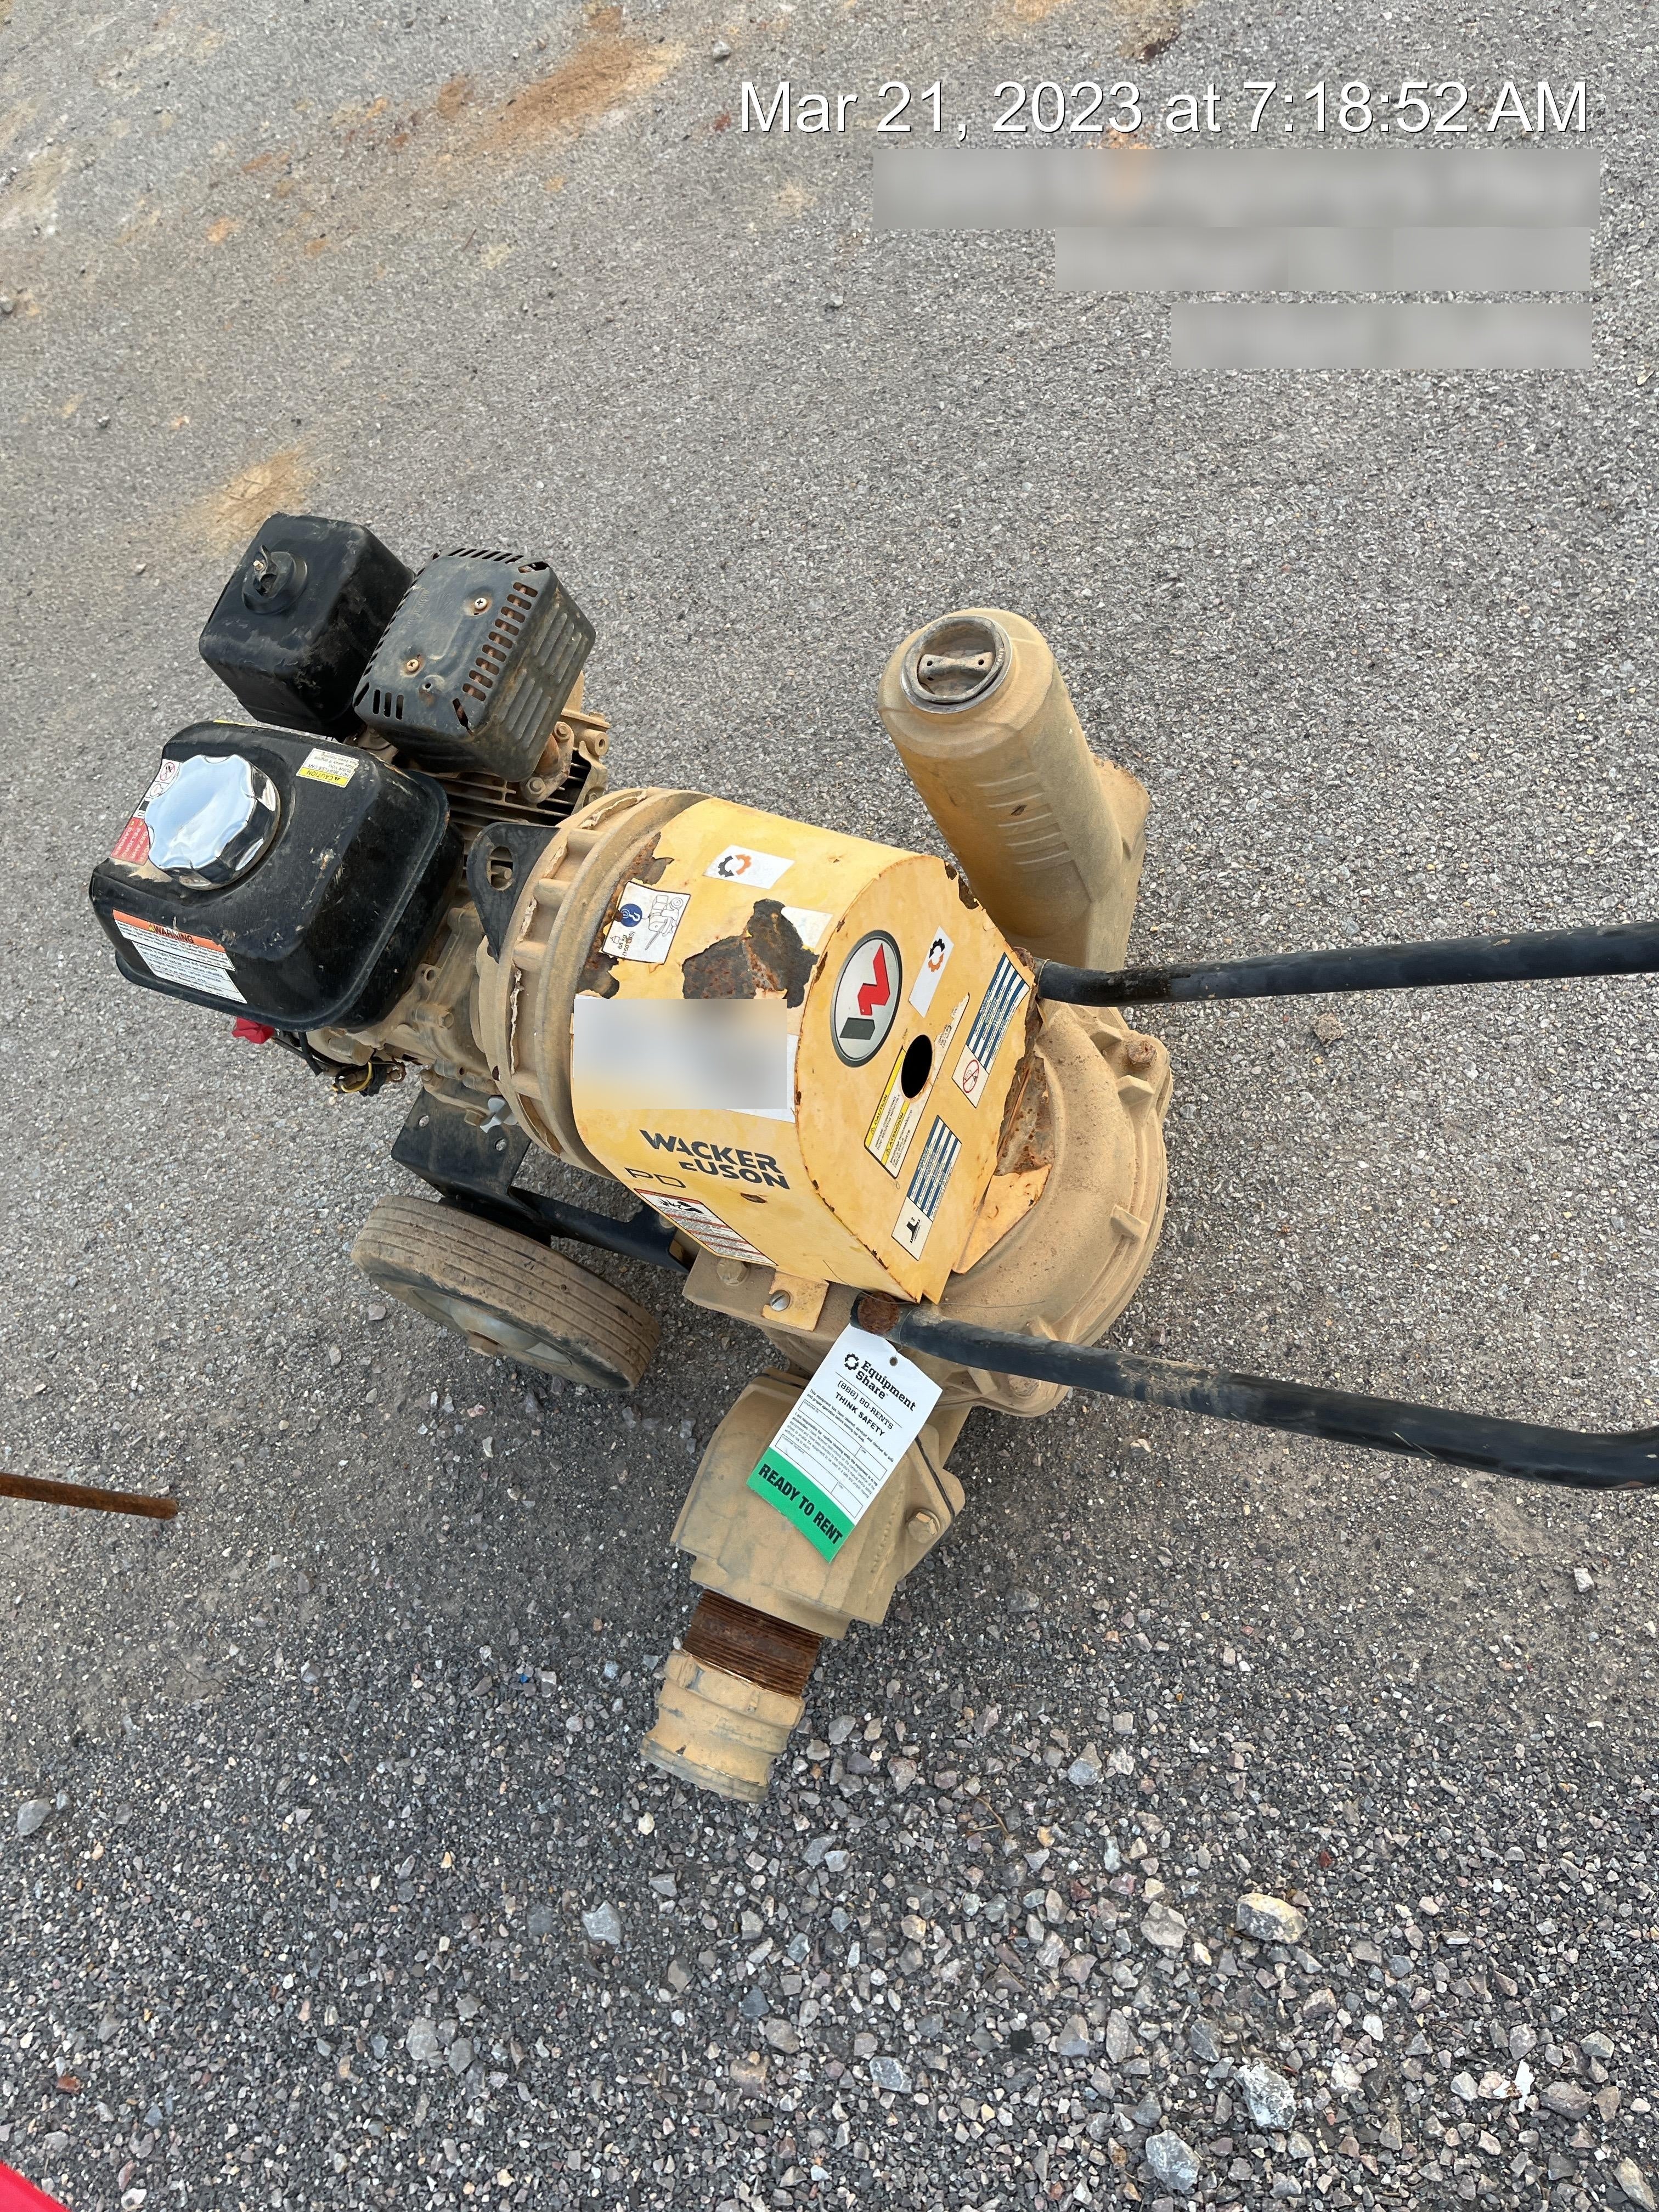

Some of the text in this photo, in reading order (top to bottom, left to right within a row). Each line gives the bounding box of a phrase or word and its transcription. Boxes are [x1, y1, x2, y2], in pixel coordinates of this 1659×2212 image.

[307, 770, 333, 780] CAUTION
[154, 925, 194, 944] WARNING
[874, 1094, 887, 1125] CAUTION
[890, 1111, 904, 1147] ATENCIÓN
[640, 1129, 783, 1174] WACKER
[679, 1159, 790, 1189] FUSON
[816, 1395, 831, 1407] equipment
[856, 1371, 885, 1399] Share
[862, 1361, 915, 1410] Equipment
[836, 1392, 884, 1436] THINK SAFETY
[838, 1380, 893, 1429] (888) 80-RENTS
[759, 1464, 842, 1544] READY TO RENT
